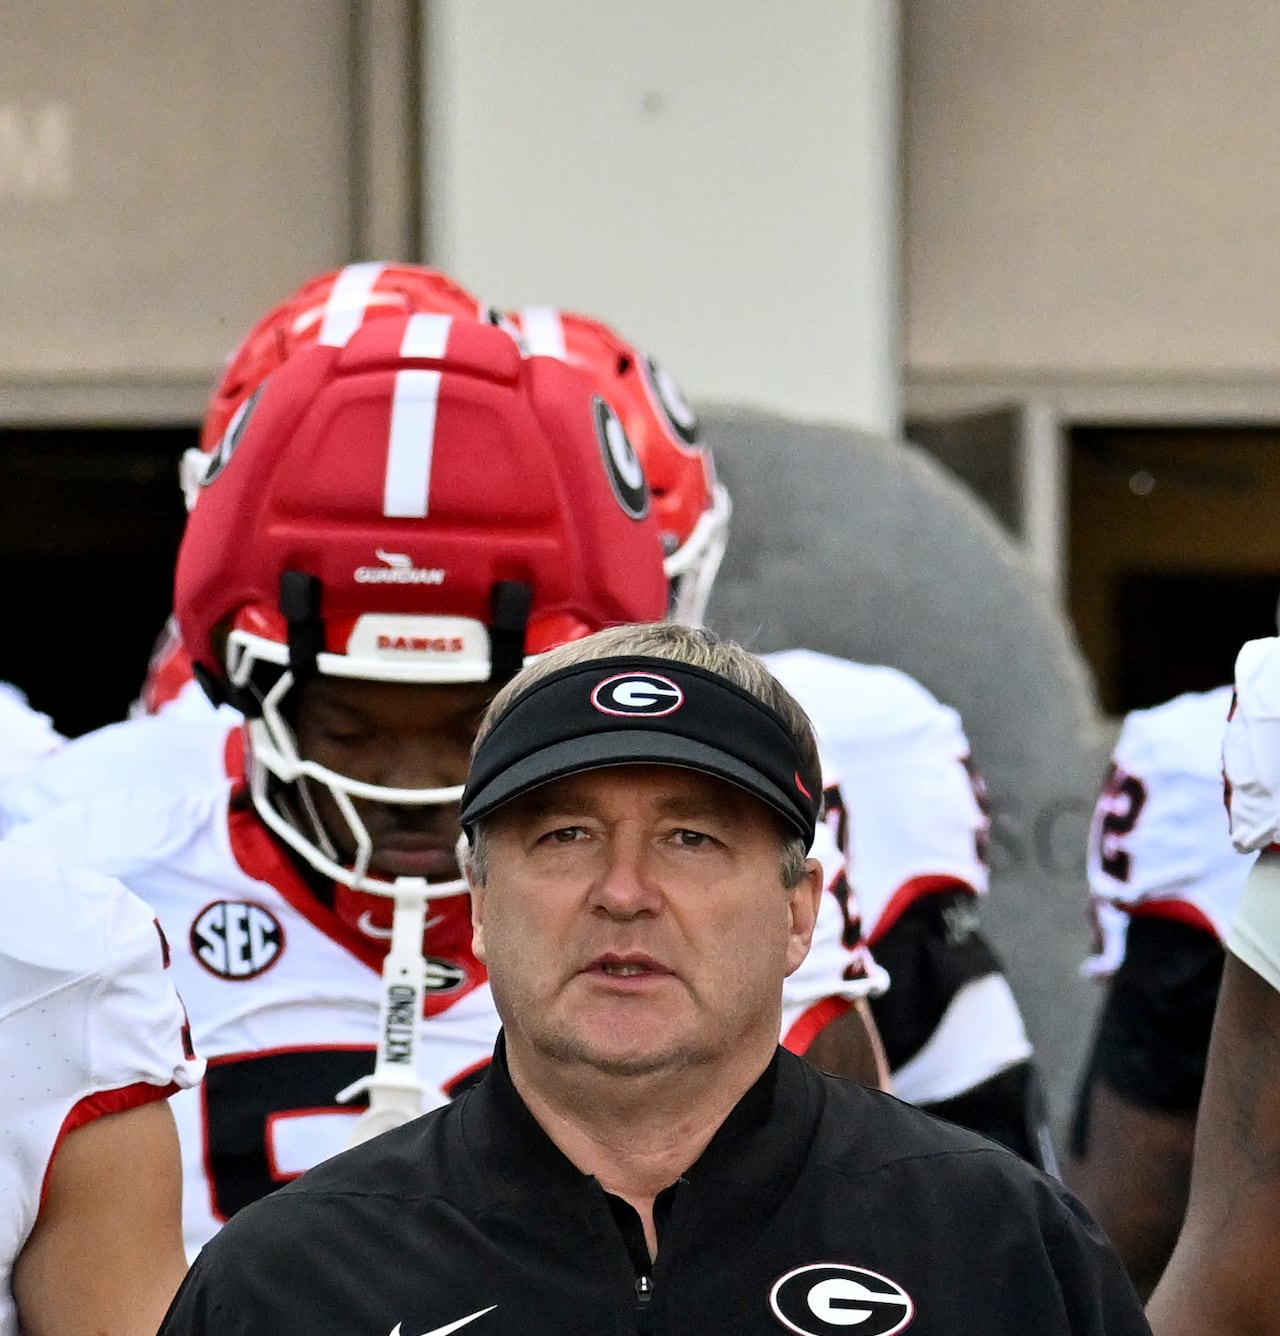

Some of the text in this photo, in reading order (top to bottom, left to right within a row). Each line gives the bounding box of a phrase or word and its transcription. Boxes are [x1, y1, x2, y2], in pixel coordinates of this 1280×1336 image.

[377, 636, 464, 652] DAWGS
[590, 671, 684, 717] G
[195, 901, 278, 977] SEC
